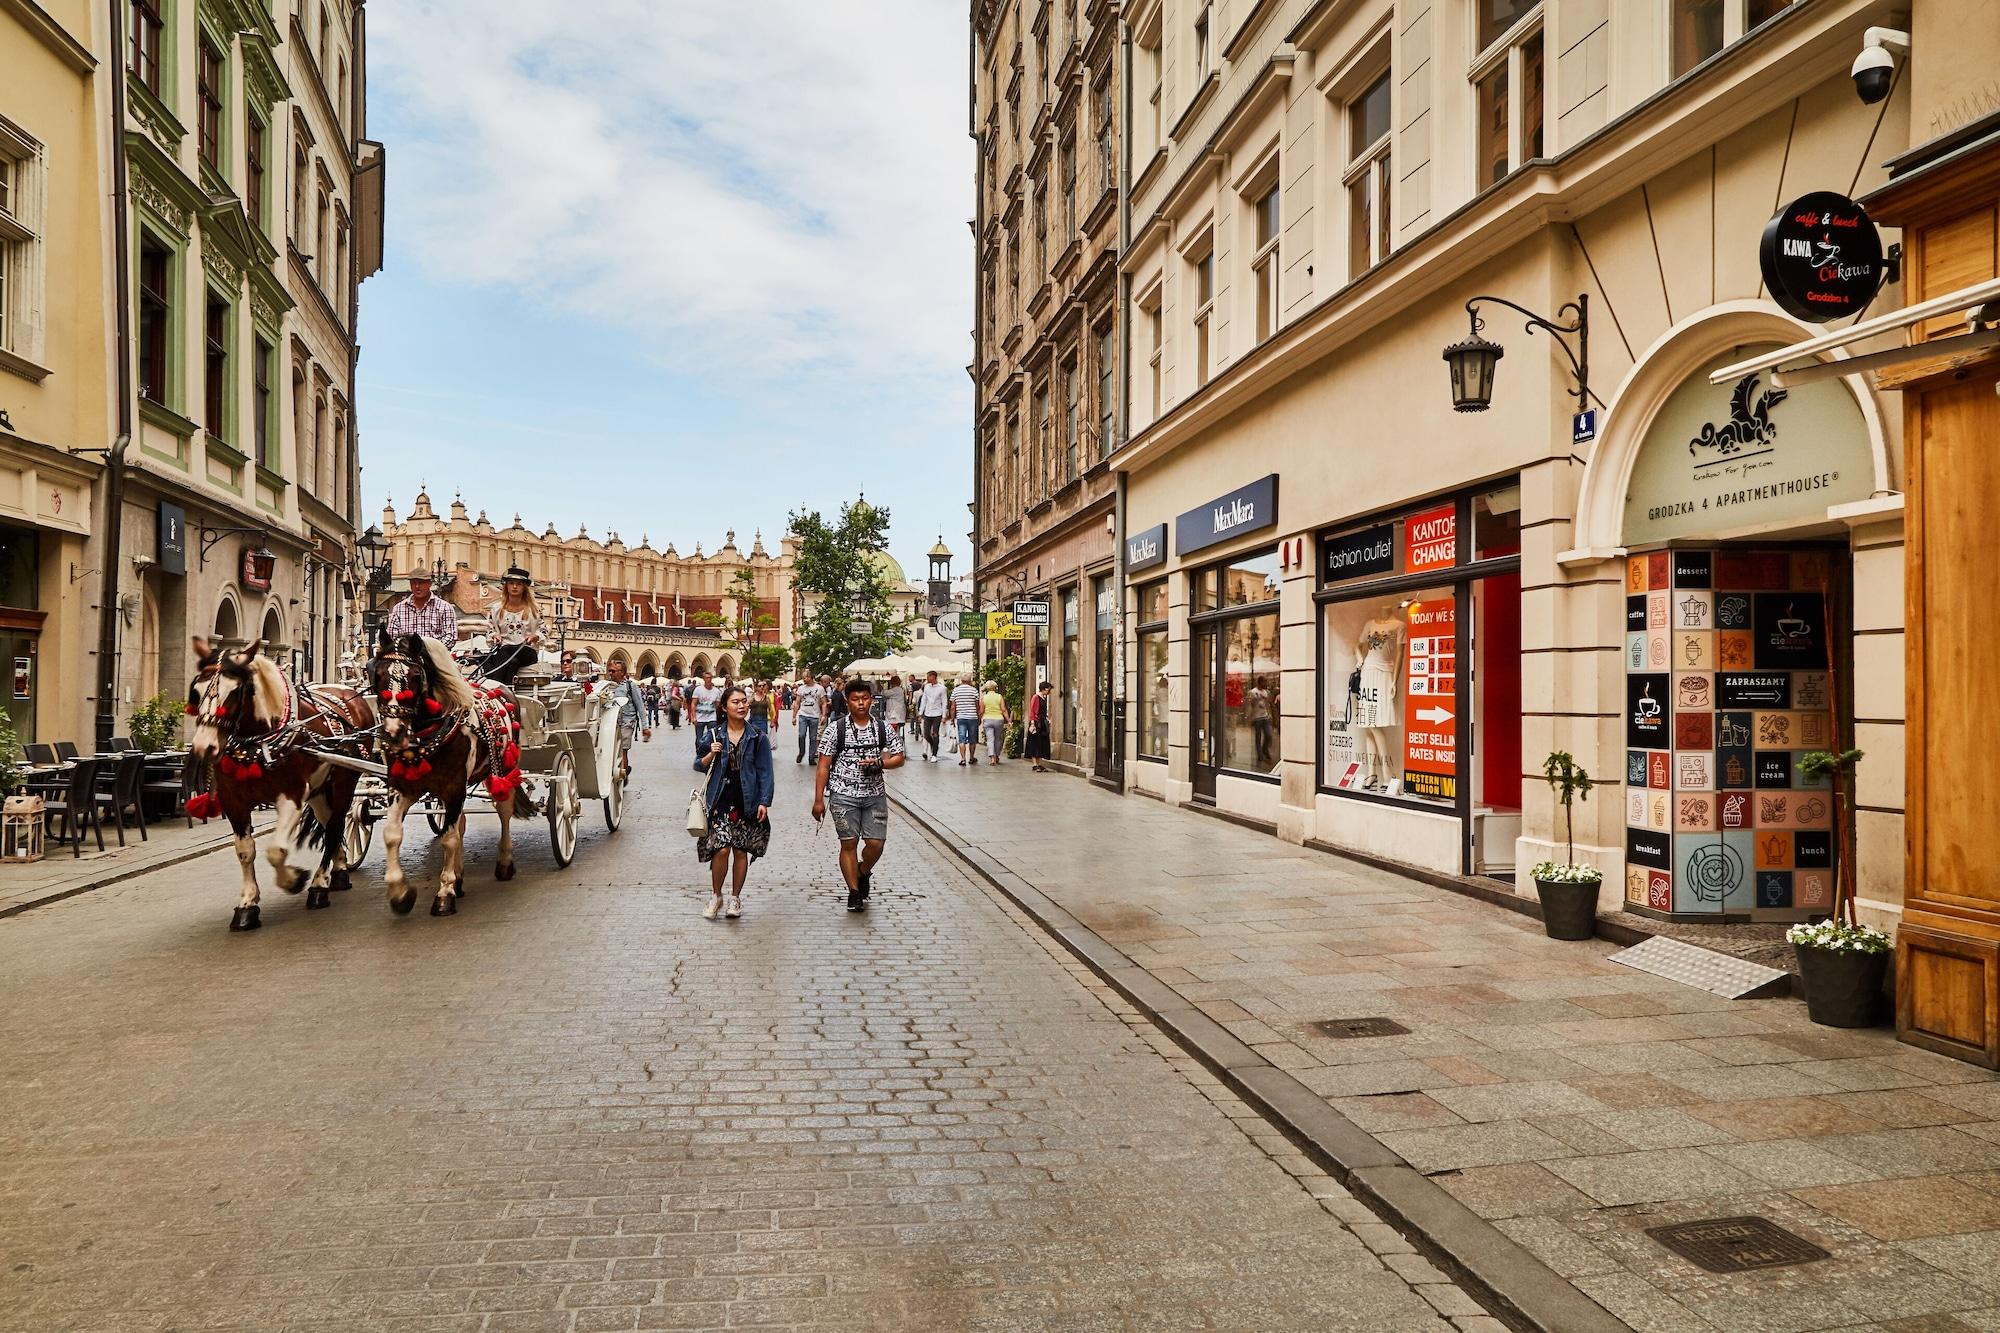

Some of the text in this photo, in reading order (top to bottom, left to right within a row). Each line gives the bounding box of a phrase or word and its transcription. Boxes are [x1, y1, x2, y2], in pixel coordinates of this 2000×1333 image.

[1821, 212, 1831, 225] &
[1832, 214, 1859, 228] lunch
[1783, 238, 1812, 258] KAWA
[1819, 262, 1870, 282] Ciekawa
[1807, 291, 1849, 304] Grodzka 4
[1580, 414, 1587, 431] 4
[1213, 498, 1254, 533] MaxMara
[1648, 500, 1695, 521] GRODZKA
[1702, 498, 1709, 510] 4
[1129, 538, 1156, 565] MaxMara
[1329, 537, 1392, 569] fashion outlet
[1677, 567, 1708, 575] dessert
[1017, 604, 1047, 614] KANTOR
[1628, 610, 1645, 619] coffee
[1017, 614, 1047, 623] EXCHANGE
[1410, 611, 1434, 624] TODAY
[1435, 610, 1448, 621] WE
[1413, 642, 1425, 652] EUR
[1413, 661, 1425, 671] USD
[1412, 682, 1425, 691] GBP
[1726, 677, 1786, 686] ZAPRASZAMY
[1356, 688, 1378, 703] SALE
[1408, 732, 1428, 744] BEST
[1409, 747, 1434, 761] RATES
[1766, 762, 1779, 770] ice
[1405, 772, 1440, 785] WESTERN
[1415, 783, 1440, 795] UNION
[1635, 844, 1662, 856] breakfast
[1801, 847, 1826, 855] lunch
